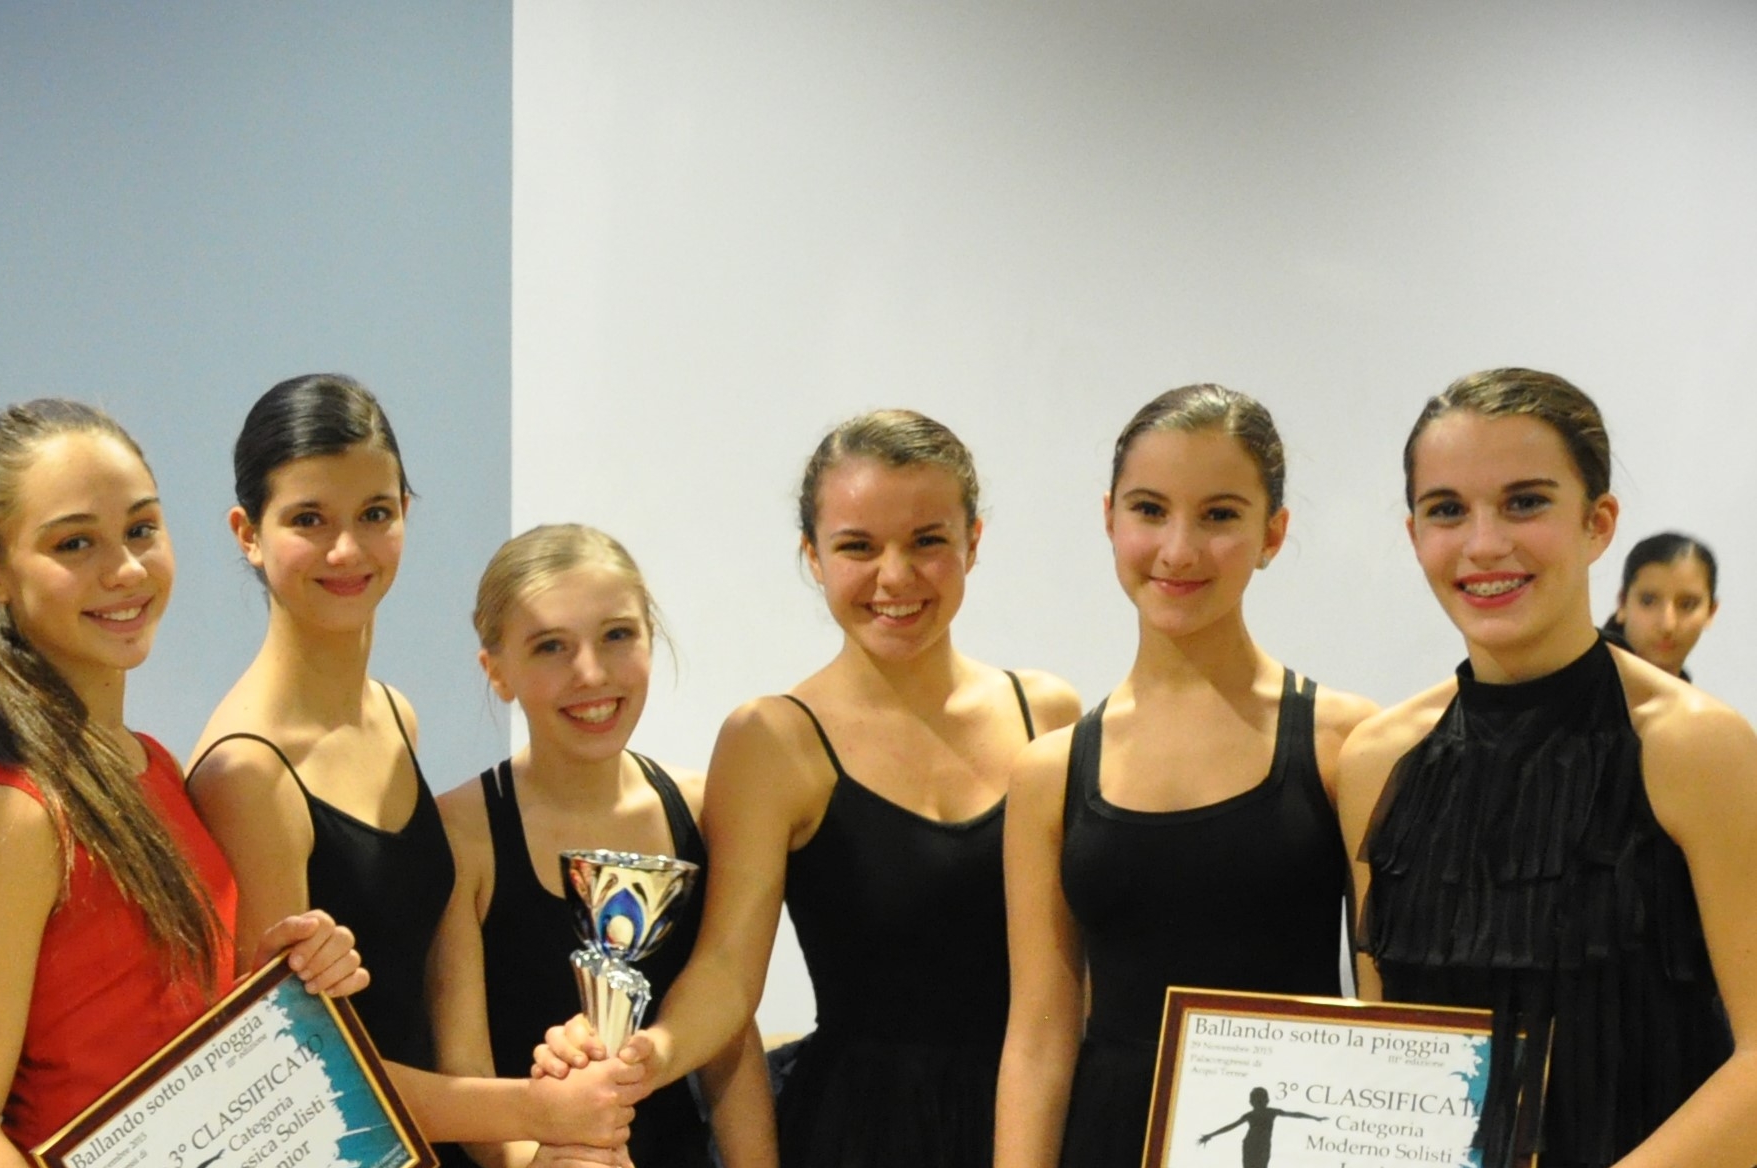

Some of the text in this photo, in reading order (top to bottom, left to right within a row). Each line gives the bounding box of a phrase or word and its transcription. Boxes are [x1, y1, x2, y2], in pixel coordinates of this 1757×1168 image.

[1195, 1017, 1451, 1059] Ballando sotto la pioggia
[145, 1077, 186, 1115] sotto
[184, 1064, 204, 1082] la
[204, 1012, 264, 1072] pioggia
[191, 1034, 324, 1150] CLASSIFICATO
[1274, 1081, 1299, 1101] 3°
[228, 1095, 294, 1152] Categoria
[276, 1094, 326, 1143] Solisti
[1335, 1114, 1425, 1139] Categoria
[1305, 1135, 1453, 1164] Moderno Solisti
